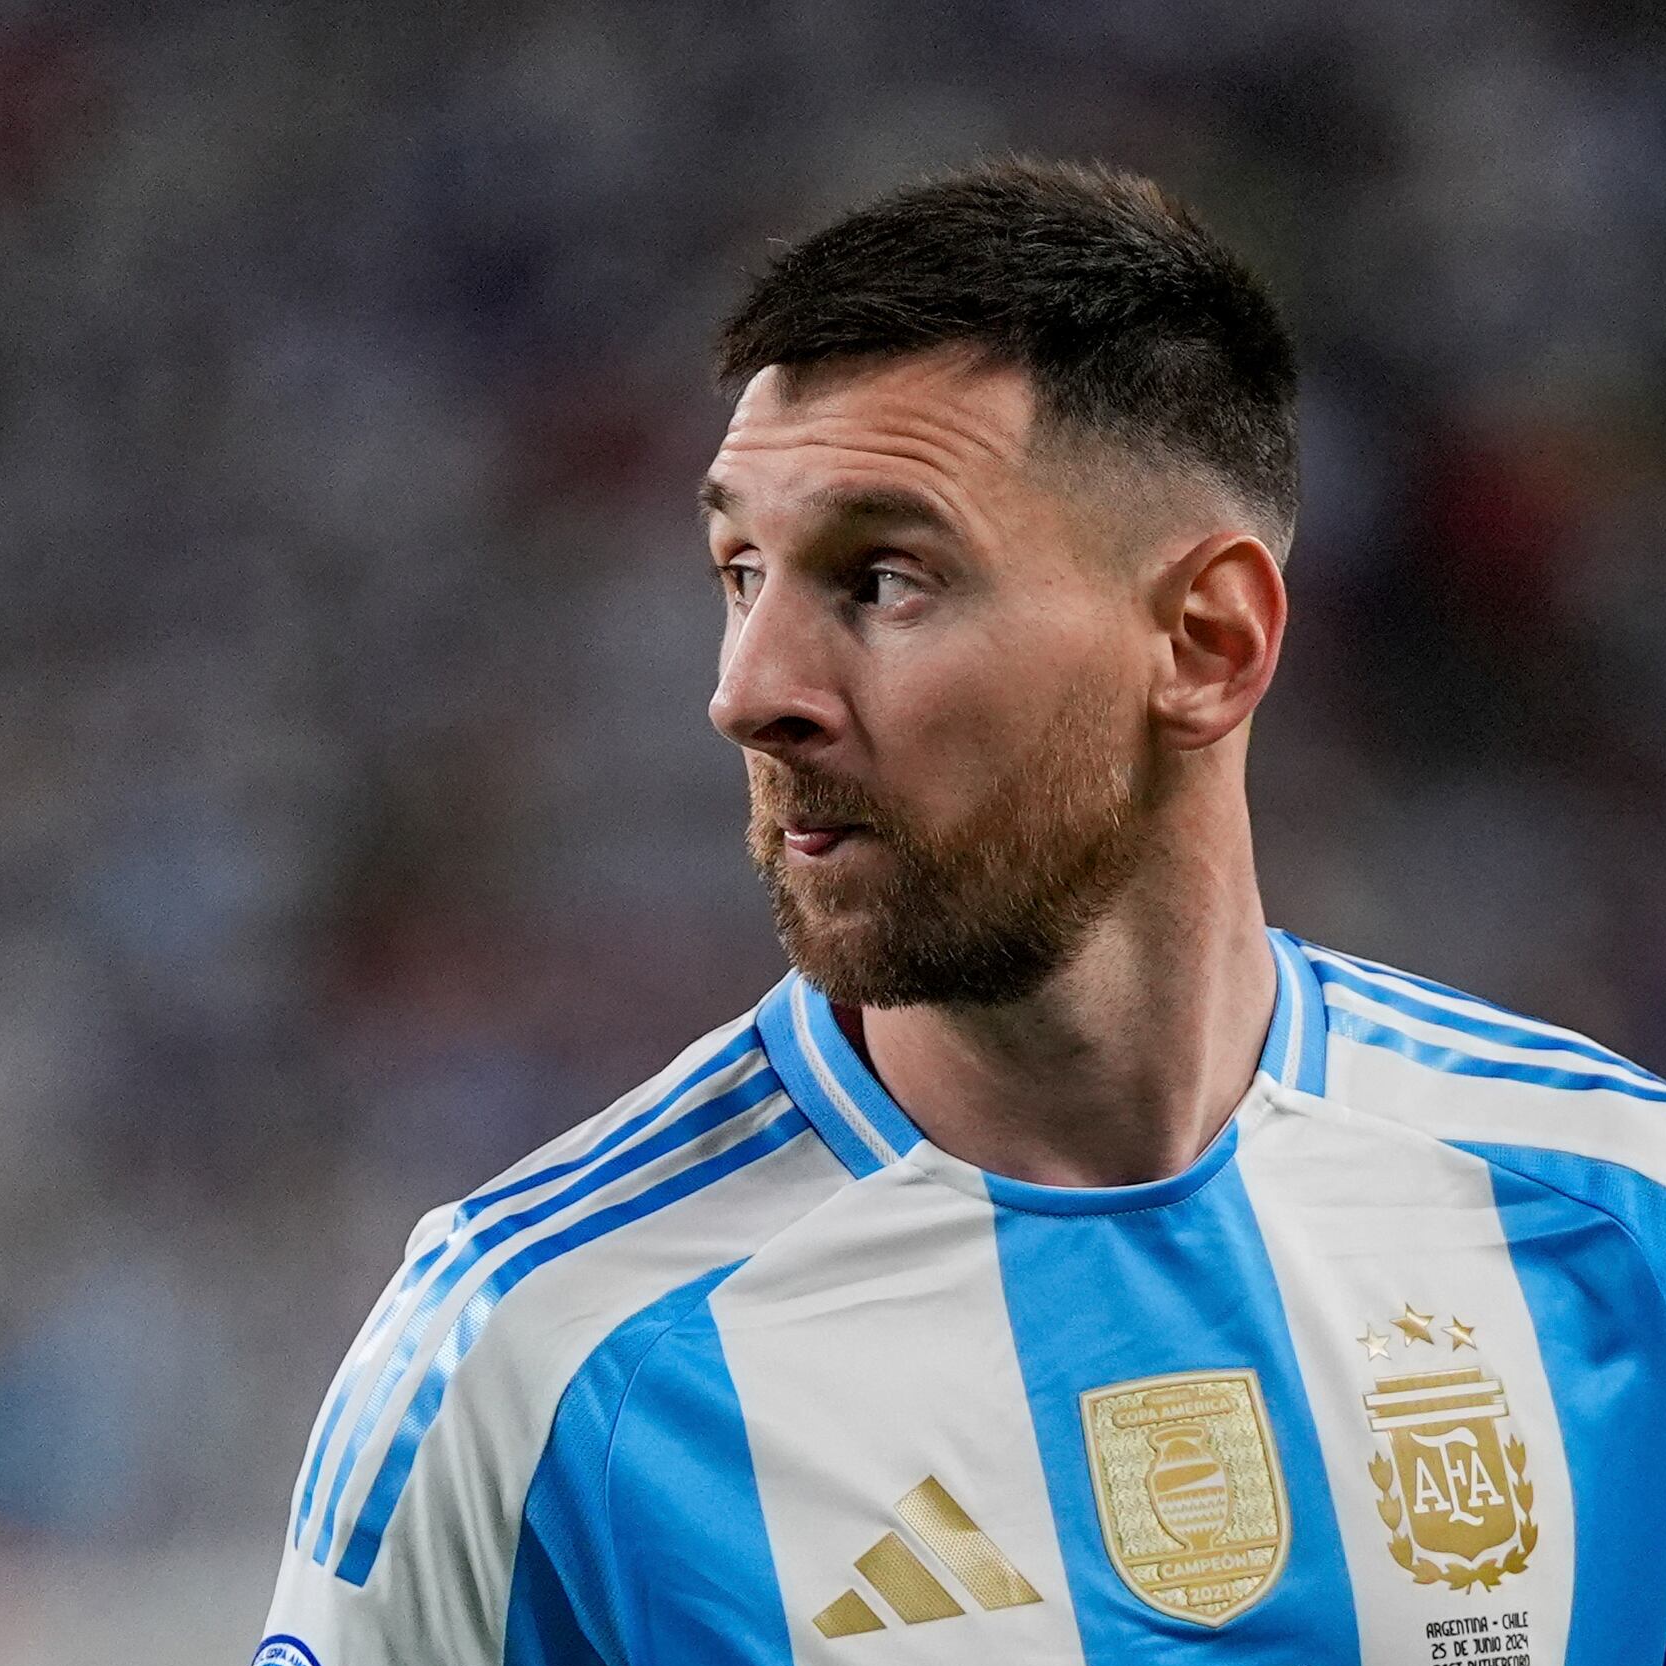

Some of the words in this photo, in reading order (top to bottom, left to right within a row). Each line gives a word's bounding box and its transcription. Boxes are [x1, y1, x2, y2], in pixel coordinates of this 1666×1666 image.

[1116, 1408, 1158, 1423] COPA
[1410, 1426, 1505, 1527] AFA
[1189, 1582, 1230, 1601] 2021
[1426, 1616, 1488, 1638] ARGENTINA
[1502, 1612, 1528, 1629] CHILE
[1431, 1643, 1447, 1659] 25
[1453, 1640, 1468, 1657] DE
[1474, 1636, 1501, 1654] JUNIO
[1506, 1633, 1529, 1651] 2024
